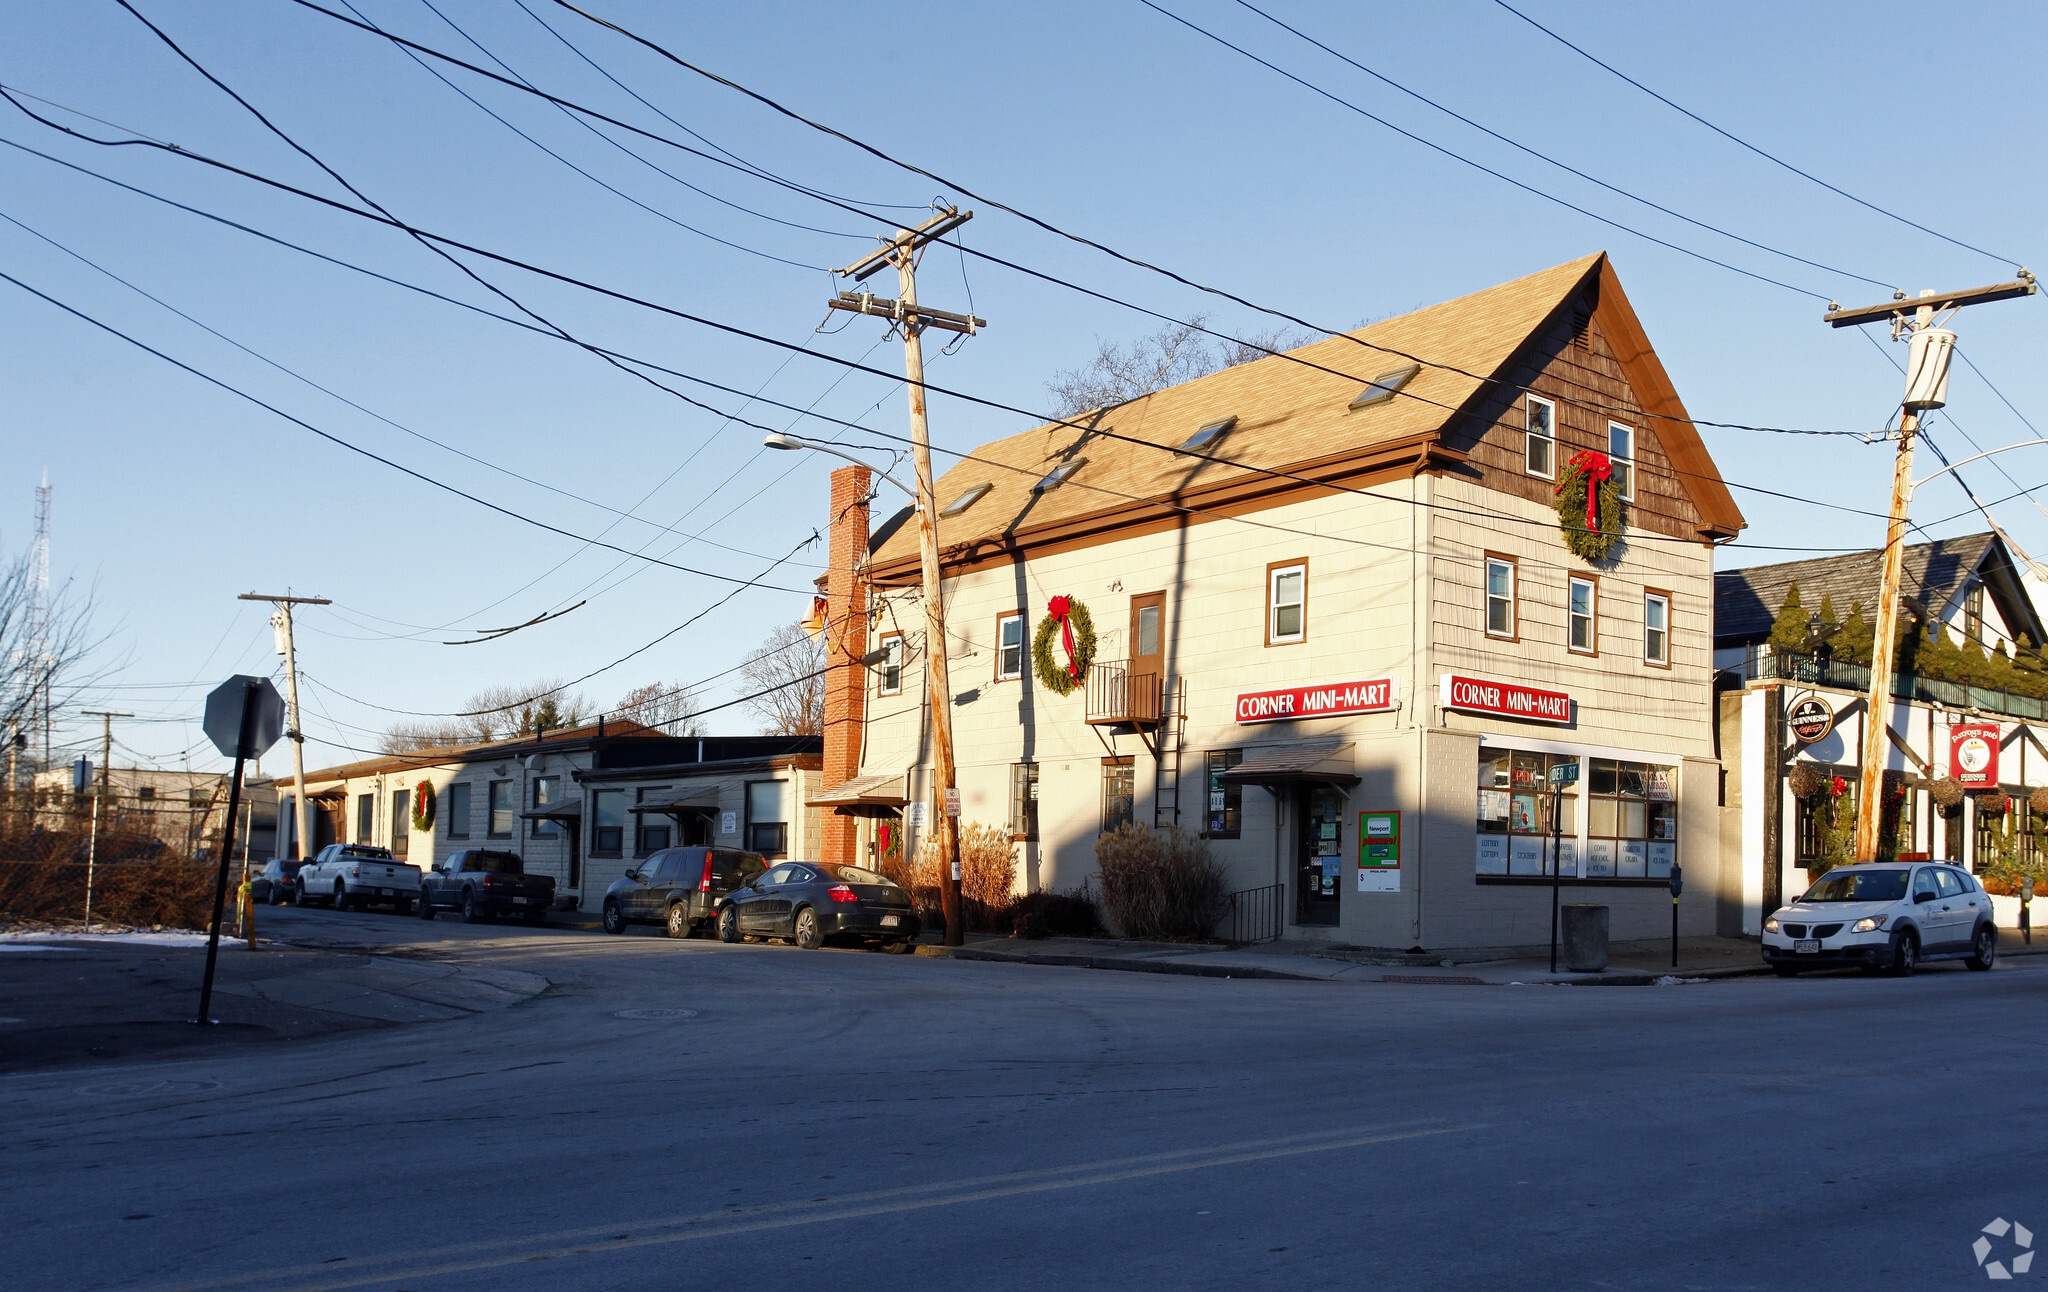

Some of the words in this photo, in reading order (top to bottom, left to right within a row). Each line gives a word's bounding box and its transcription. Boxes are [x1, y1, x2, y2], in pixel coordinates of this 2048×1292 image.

[1239, 694, 1295, 717] CORNER
[1303, 684, 1387, 711] MINI-MART
[1453, 682, 1501, 707] CORNER
[1506, 690, 1567, 717] MINI-MART
[1792, 714, 1830, 726] GUINNESS
[1511, 768, 1534, 784] OPEN
[1568, 766, 1577, 779] ST
[1362, 836, 1397, 847] pleasure!
[1481, 839, 1499, 847] LOTTERY
[1593, 844, 1607, 852] COFFEE
[1481, 850, 1499, 858] LOTTERY
[1624, 855, 1638, 863] CIGARS
[1360, 873, 1364, 882] $
